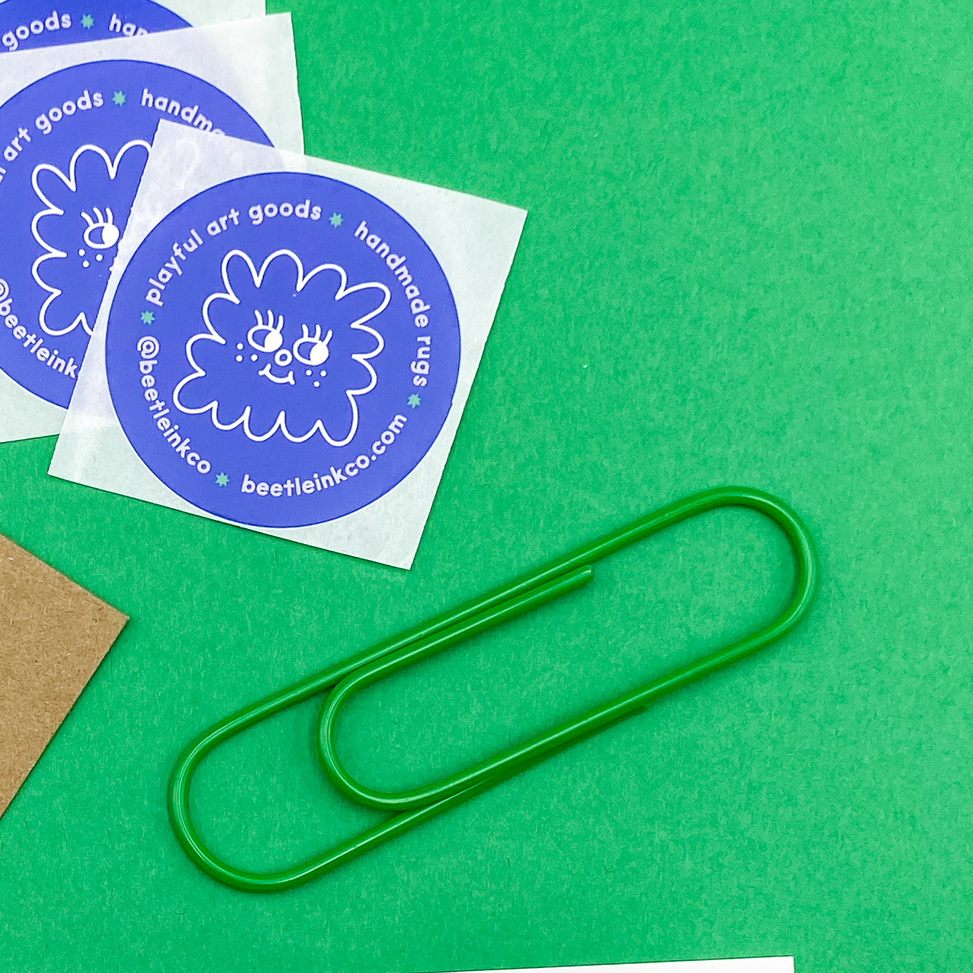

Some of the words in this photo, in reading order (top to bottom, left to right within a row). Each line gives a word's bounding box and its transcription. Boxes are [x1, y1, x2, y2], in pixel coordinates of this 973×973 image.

[1, 10, 71, 51] goods
[2, 125, 32, 162] art
[35, 90, 104, 134] goods
[146, 229, 204, 306] playful
[207, 208, 240, 236] art
[248, 199, 322, 225] goods
[354, 221, 430, 328] handmade
[410, 336, 431, 386] rugs
[137, 336, 212, 473] @beetleinkco
[241, 414, 407, 496] beetleinkco.com
